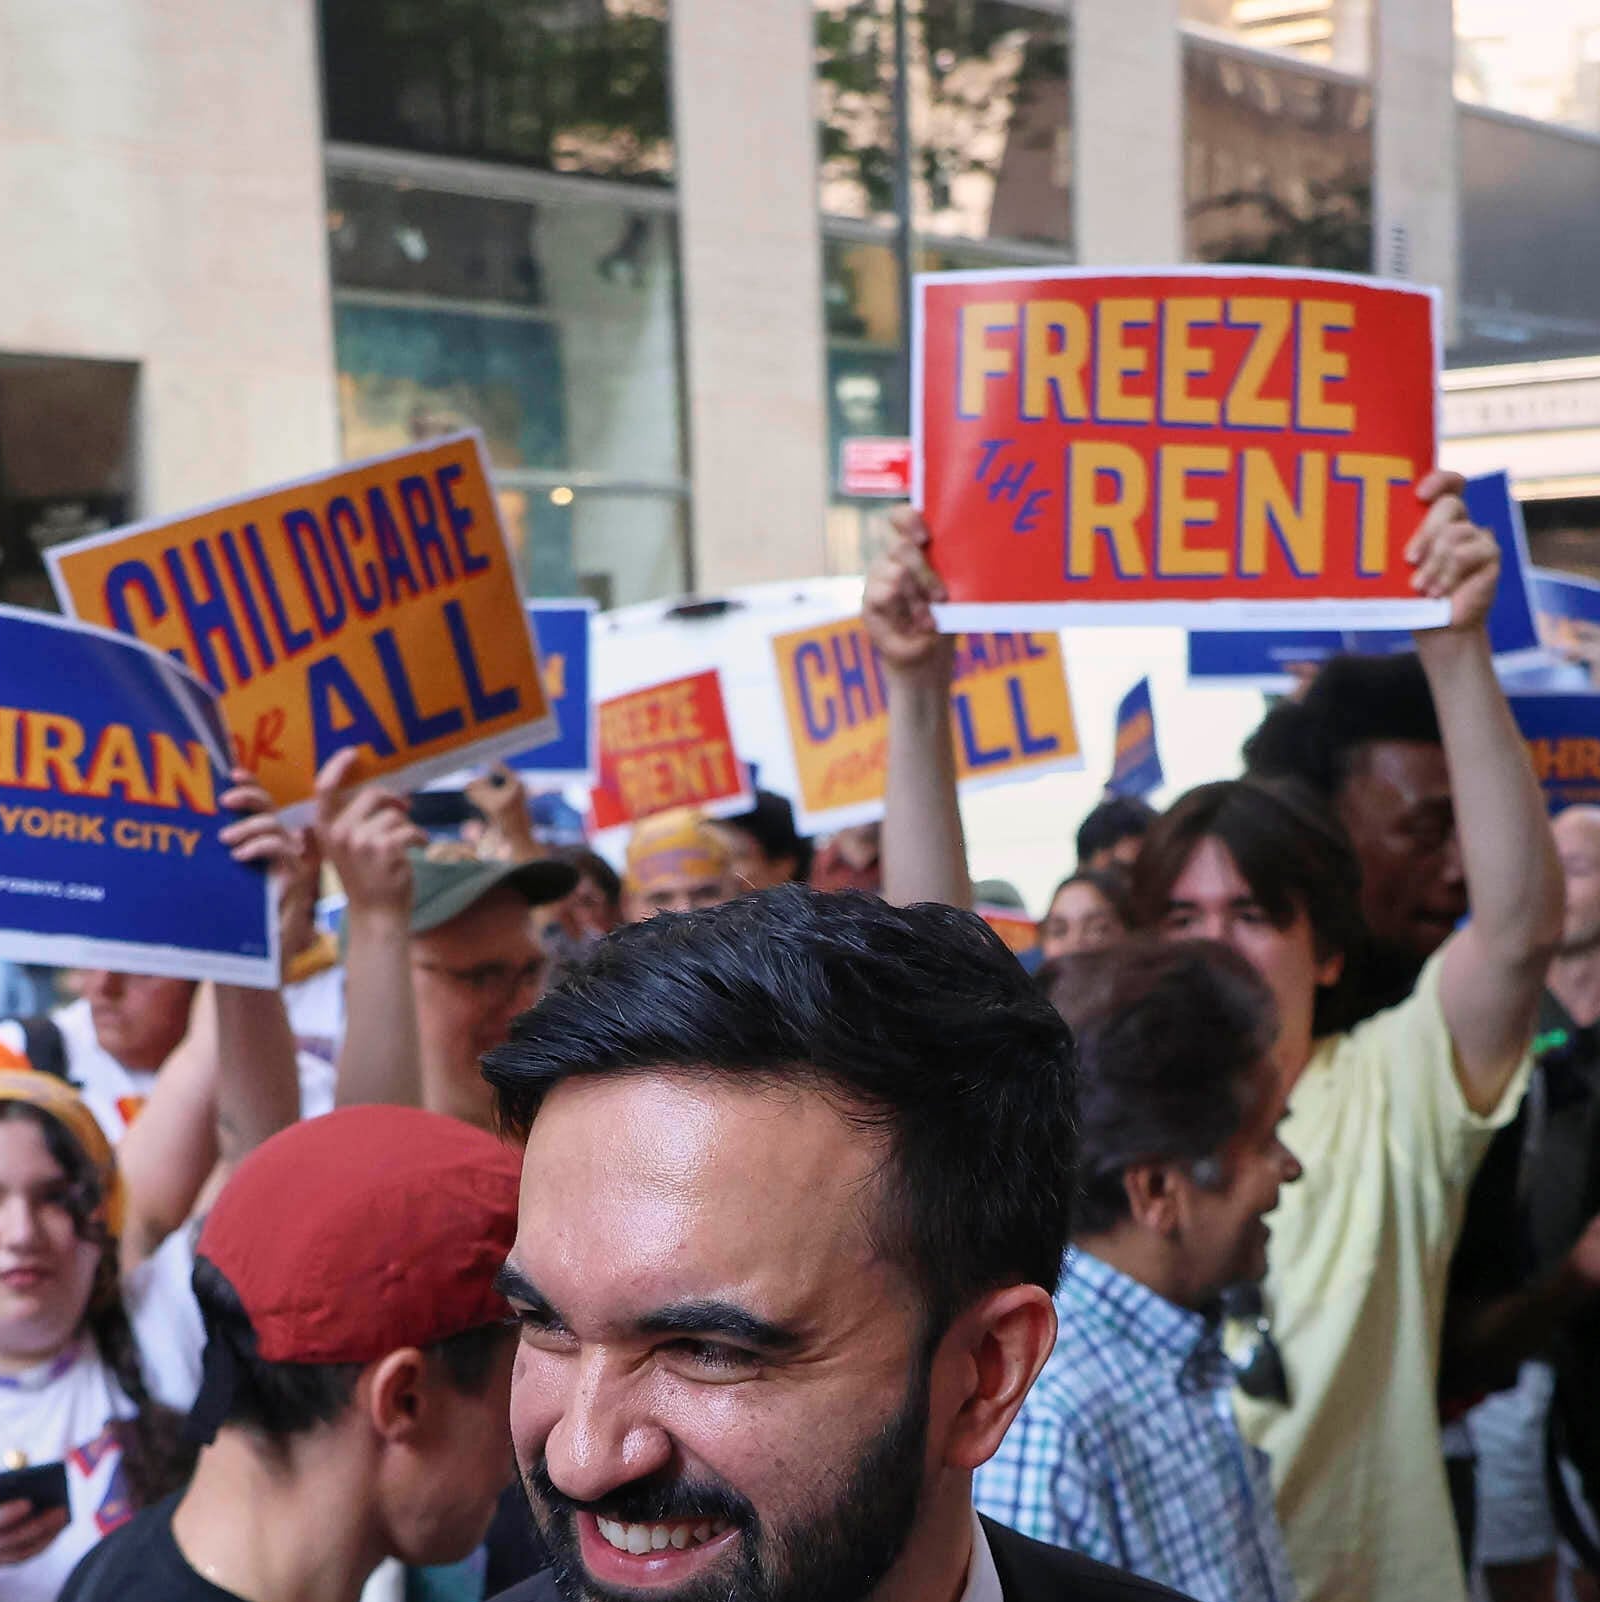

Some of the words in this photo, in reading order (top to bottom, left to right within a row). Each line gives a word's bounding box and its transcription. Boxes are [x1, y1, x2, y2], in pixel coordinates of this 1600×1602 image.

[953, 297, 1356, 434] FREEZE
[974, 439, 1052, 534] THE
[1062, 440, 1414, 581] RENT
[104, 463, 490, 697] CHILDCARE
[306, 600, 520, 785] ALL
[953, 676, 1057, 765] LL
[112, 819, 201, 857] CITY
